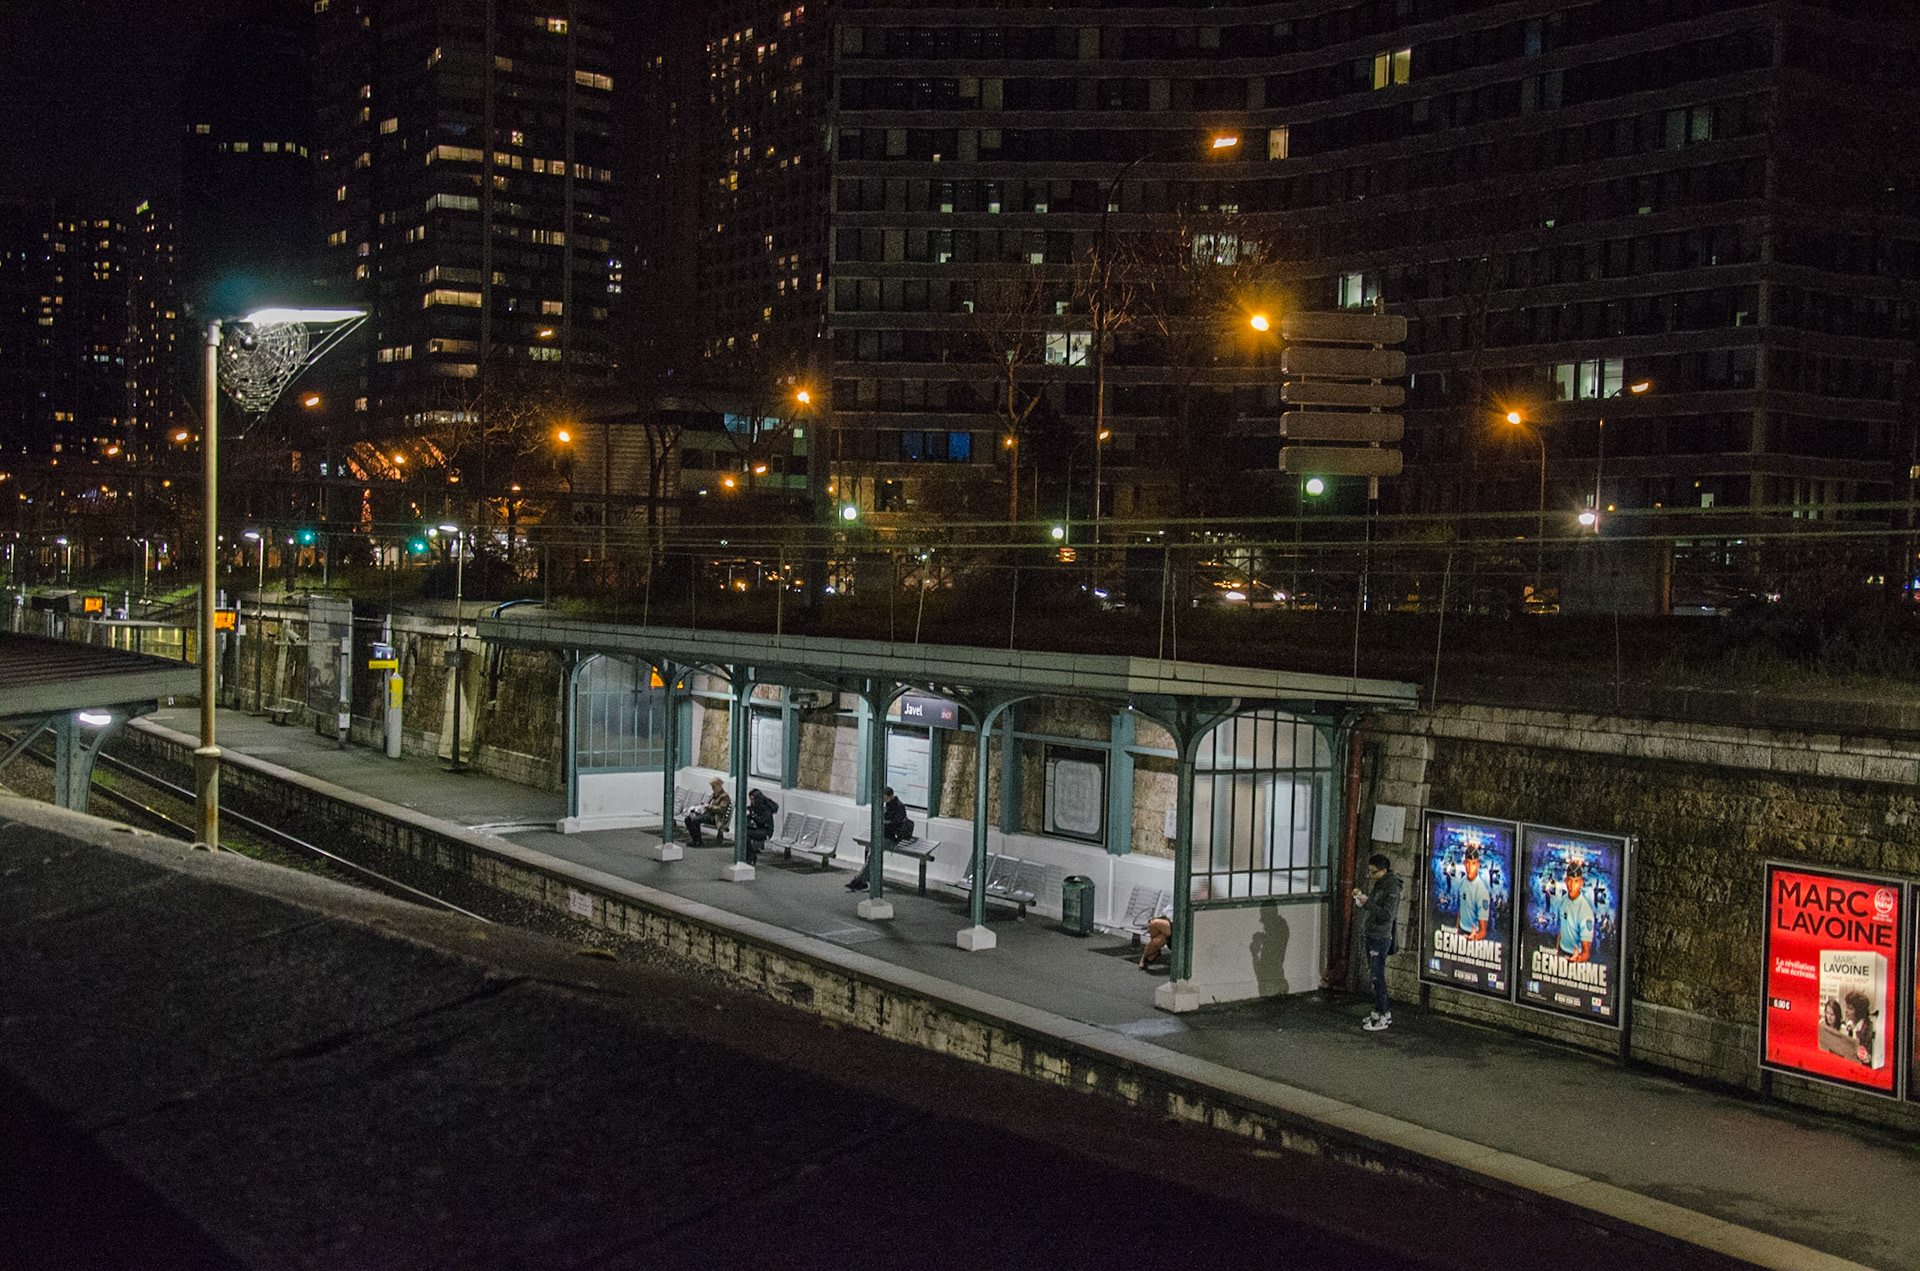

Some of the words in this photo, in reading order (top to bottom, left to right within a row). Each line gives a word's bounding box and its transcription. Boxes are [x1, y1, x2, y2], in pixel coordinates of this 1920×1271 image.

[904, 703, 923, 716] Javel
[1779, 880, 1869, 917] MARC
[1777, 909, 1893, 947] LAVOINE
[1434, 929, 1502, 963] GENDARME
[1776, 957, 1784, 965] La
[1785, 958, 1816, 972] révélation
[1833, 955, 1857, 964] MARC
[1532, 951, 1607, 986] GENDARME
[1775, 965, 1790, 974] d'un
[1790, 968, 1817, 980] écrivain.
[1823, 963, 1870, 976] LAVOINE
